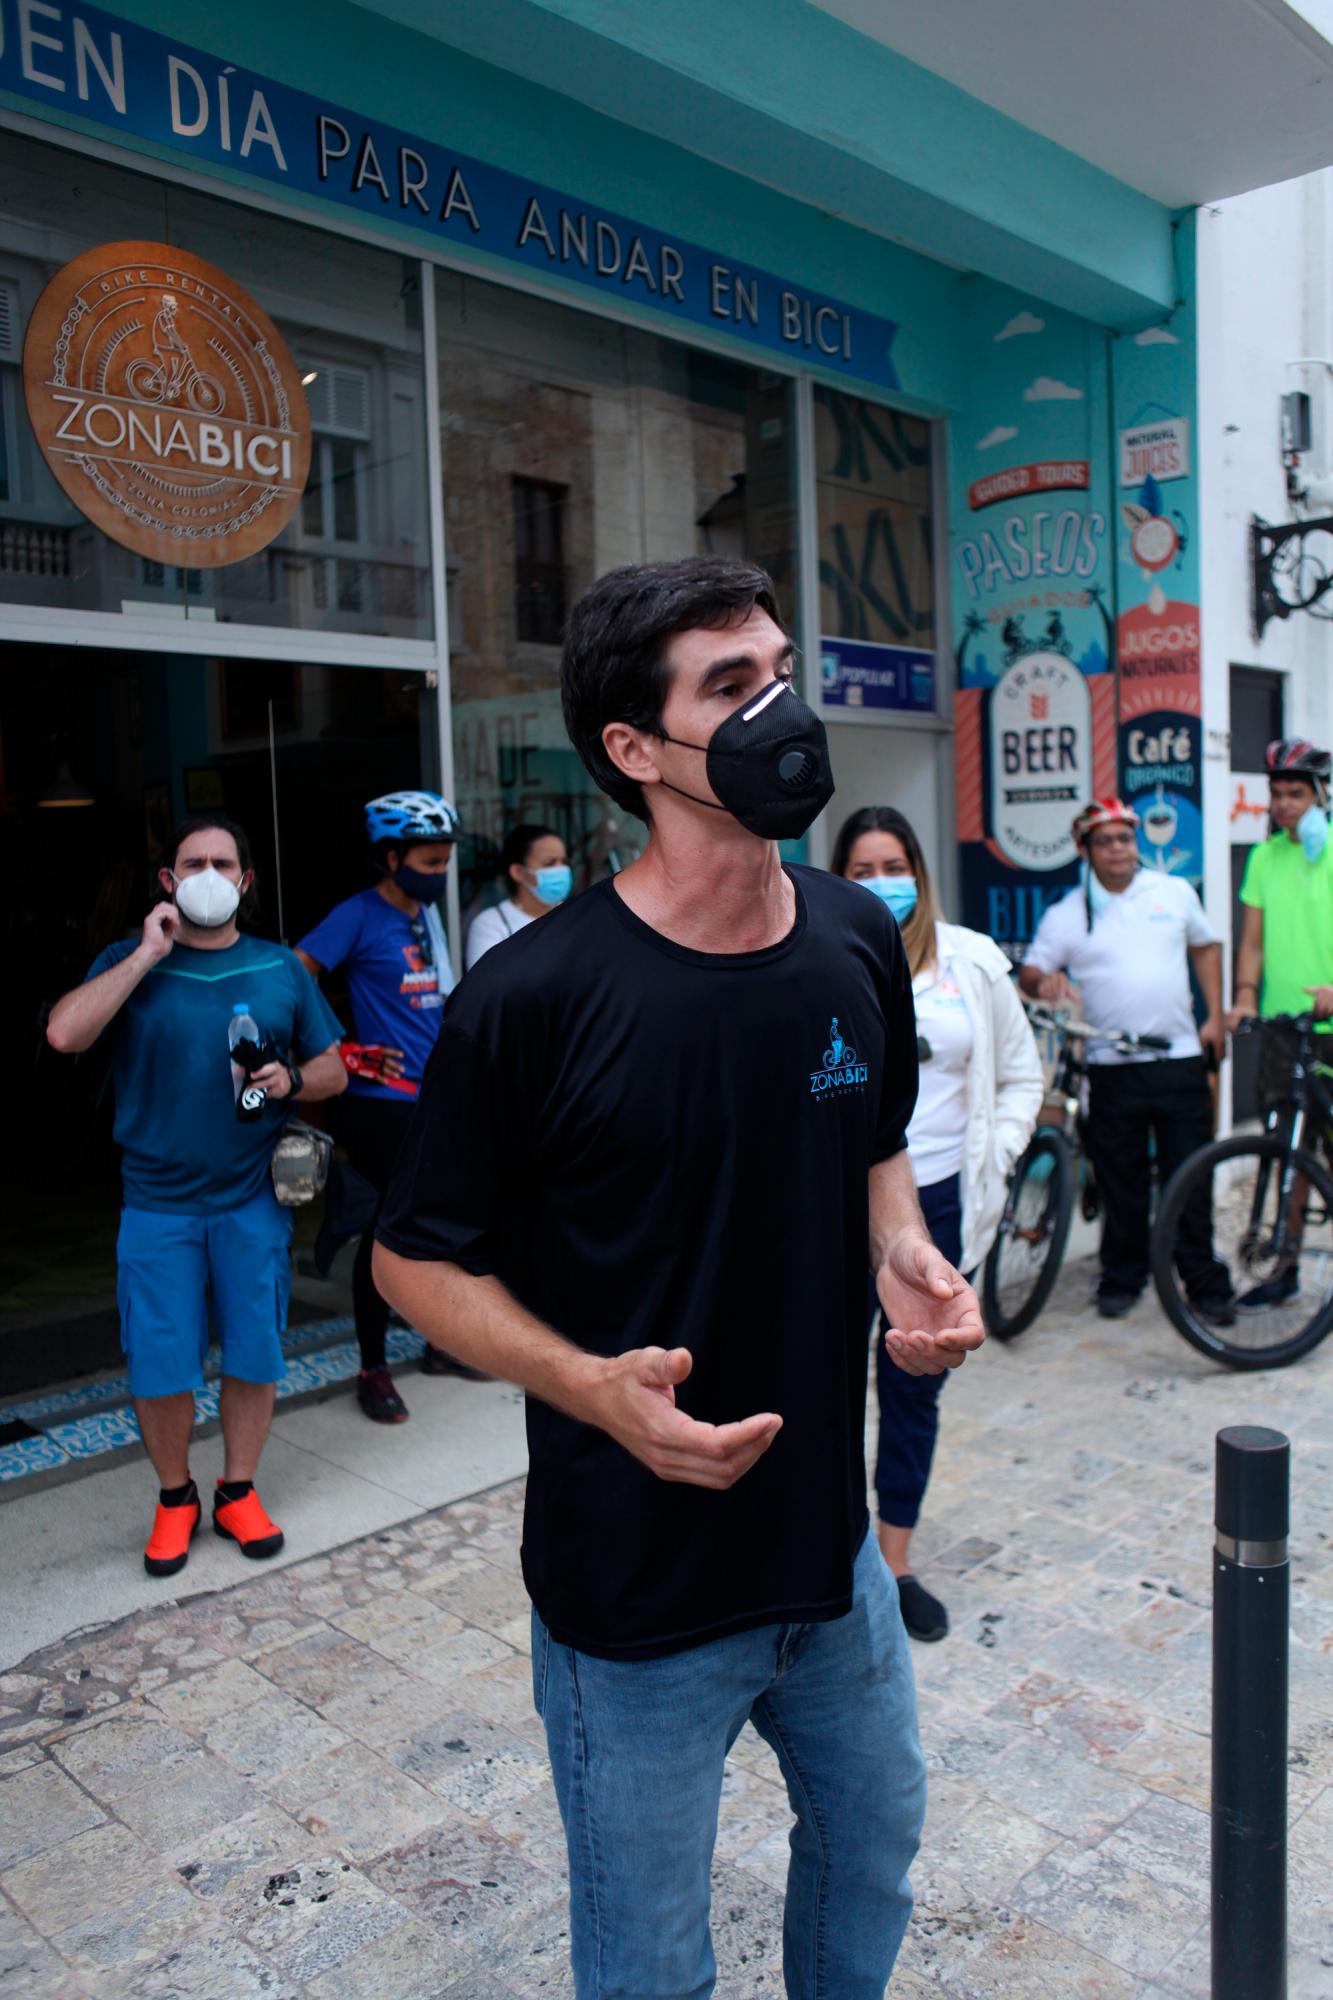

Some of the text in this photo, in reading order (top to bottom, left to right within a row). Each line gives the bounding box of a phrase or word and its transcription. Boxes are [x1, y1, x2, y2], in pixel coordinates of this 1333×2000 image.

[0, 0, 853, 360] EN DÍA PARA ANDAR EN BICI
[100, 270, 243, 327] BIKE RENTAL
[52, 393, 292, 480] ZONABICI
[126, 481, 165, 512] ZONA
[957, 508, 1106, 600] PASEOS
[1120, 622, 1199, 656] JUGOS
[1002, 664, 1068, 699] CRAFT
[1002, 723, 1077, 774] BEER
[1127, 726, 1192, 764] Café
[987, 884, 1076, 943] BIK
[810, 1066, 868, 1093] ZONABICI
